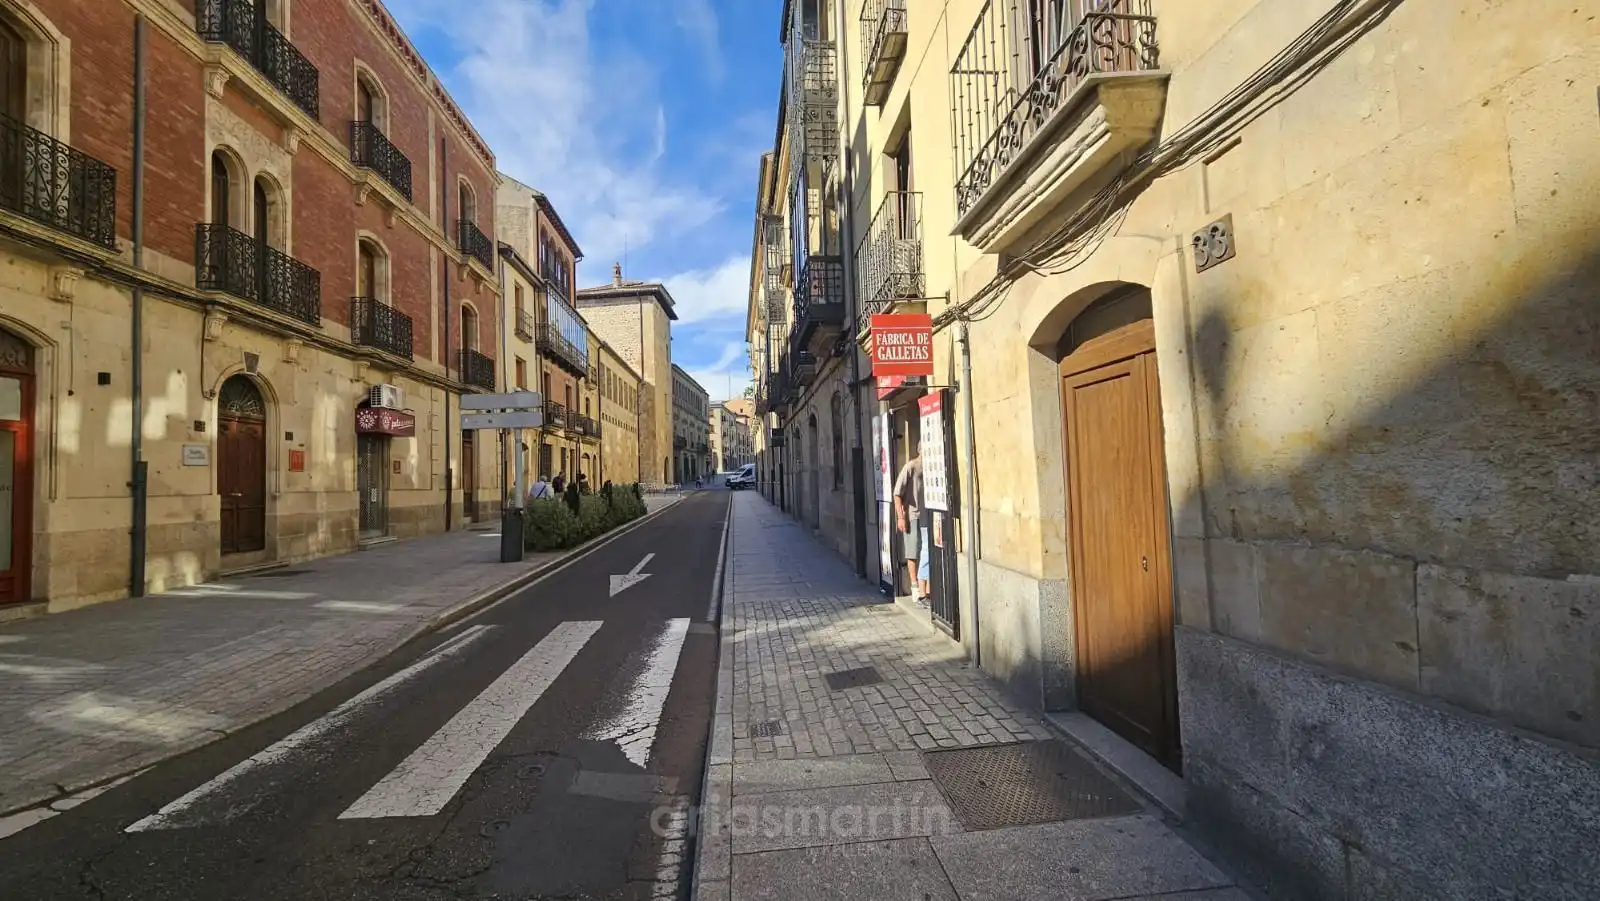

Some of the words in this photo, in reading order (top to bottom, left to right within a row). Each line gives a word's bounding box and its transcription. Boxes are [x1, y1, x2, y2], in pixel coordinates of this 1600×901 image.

[1192, 222, 1229, 267] 38
[876, 331, 914, 346] FÁBRICA
[917, 333, 929, 344] DE
[878, 346, 929, 360] GALLETAS
